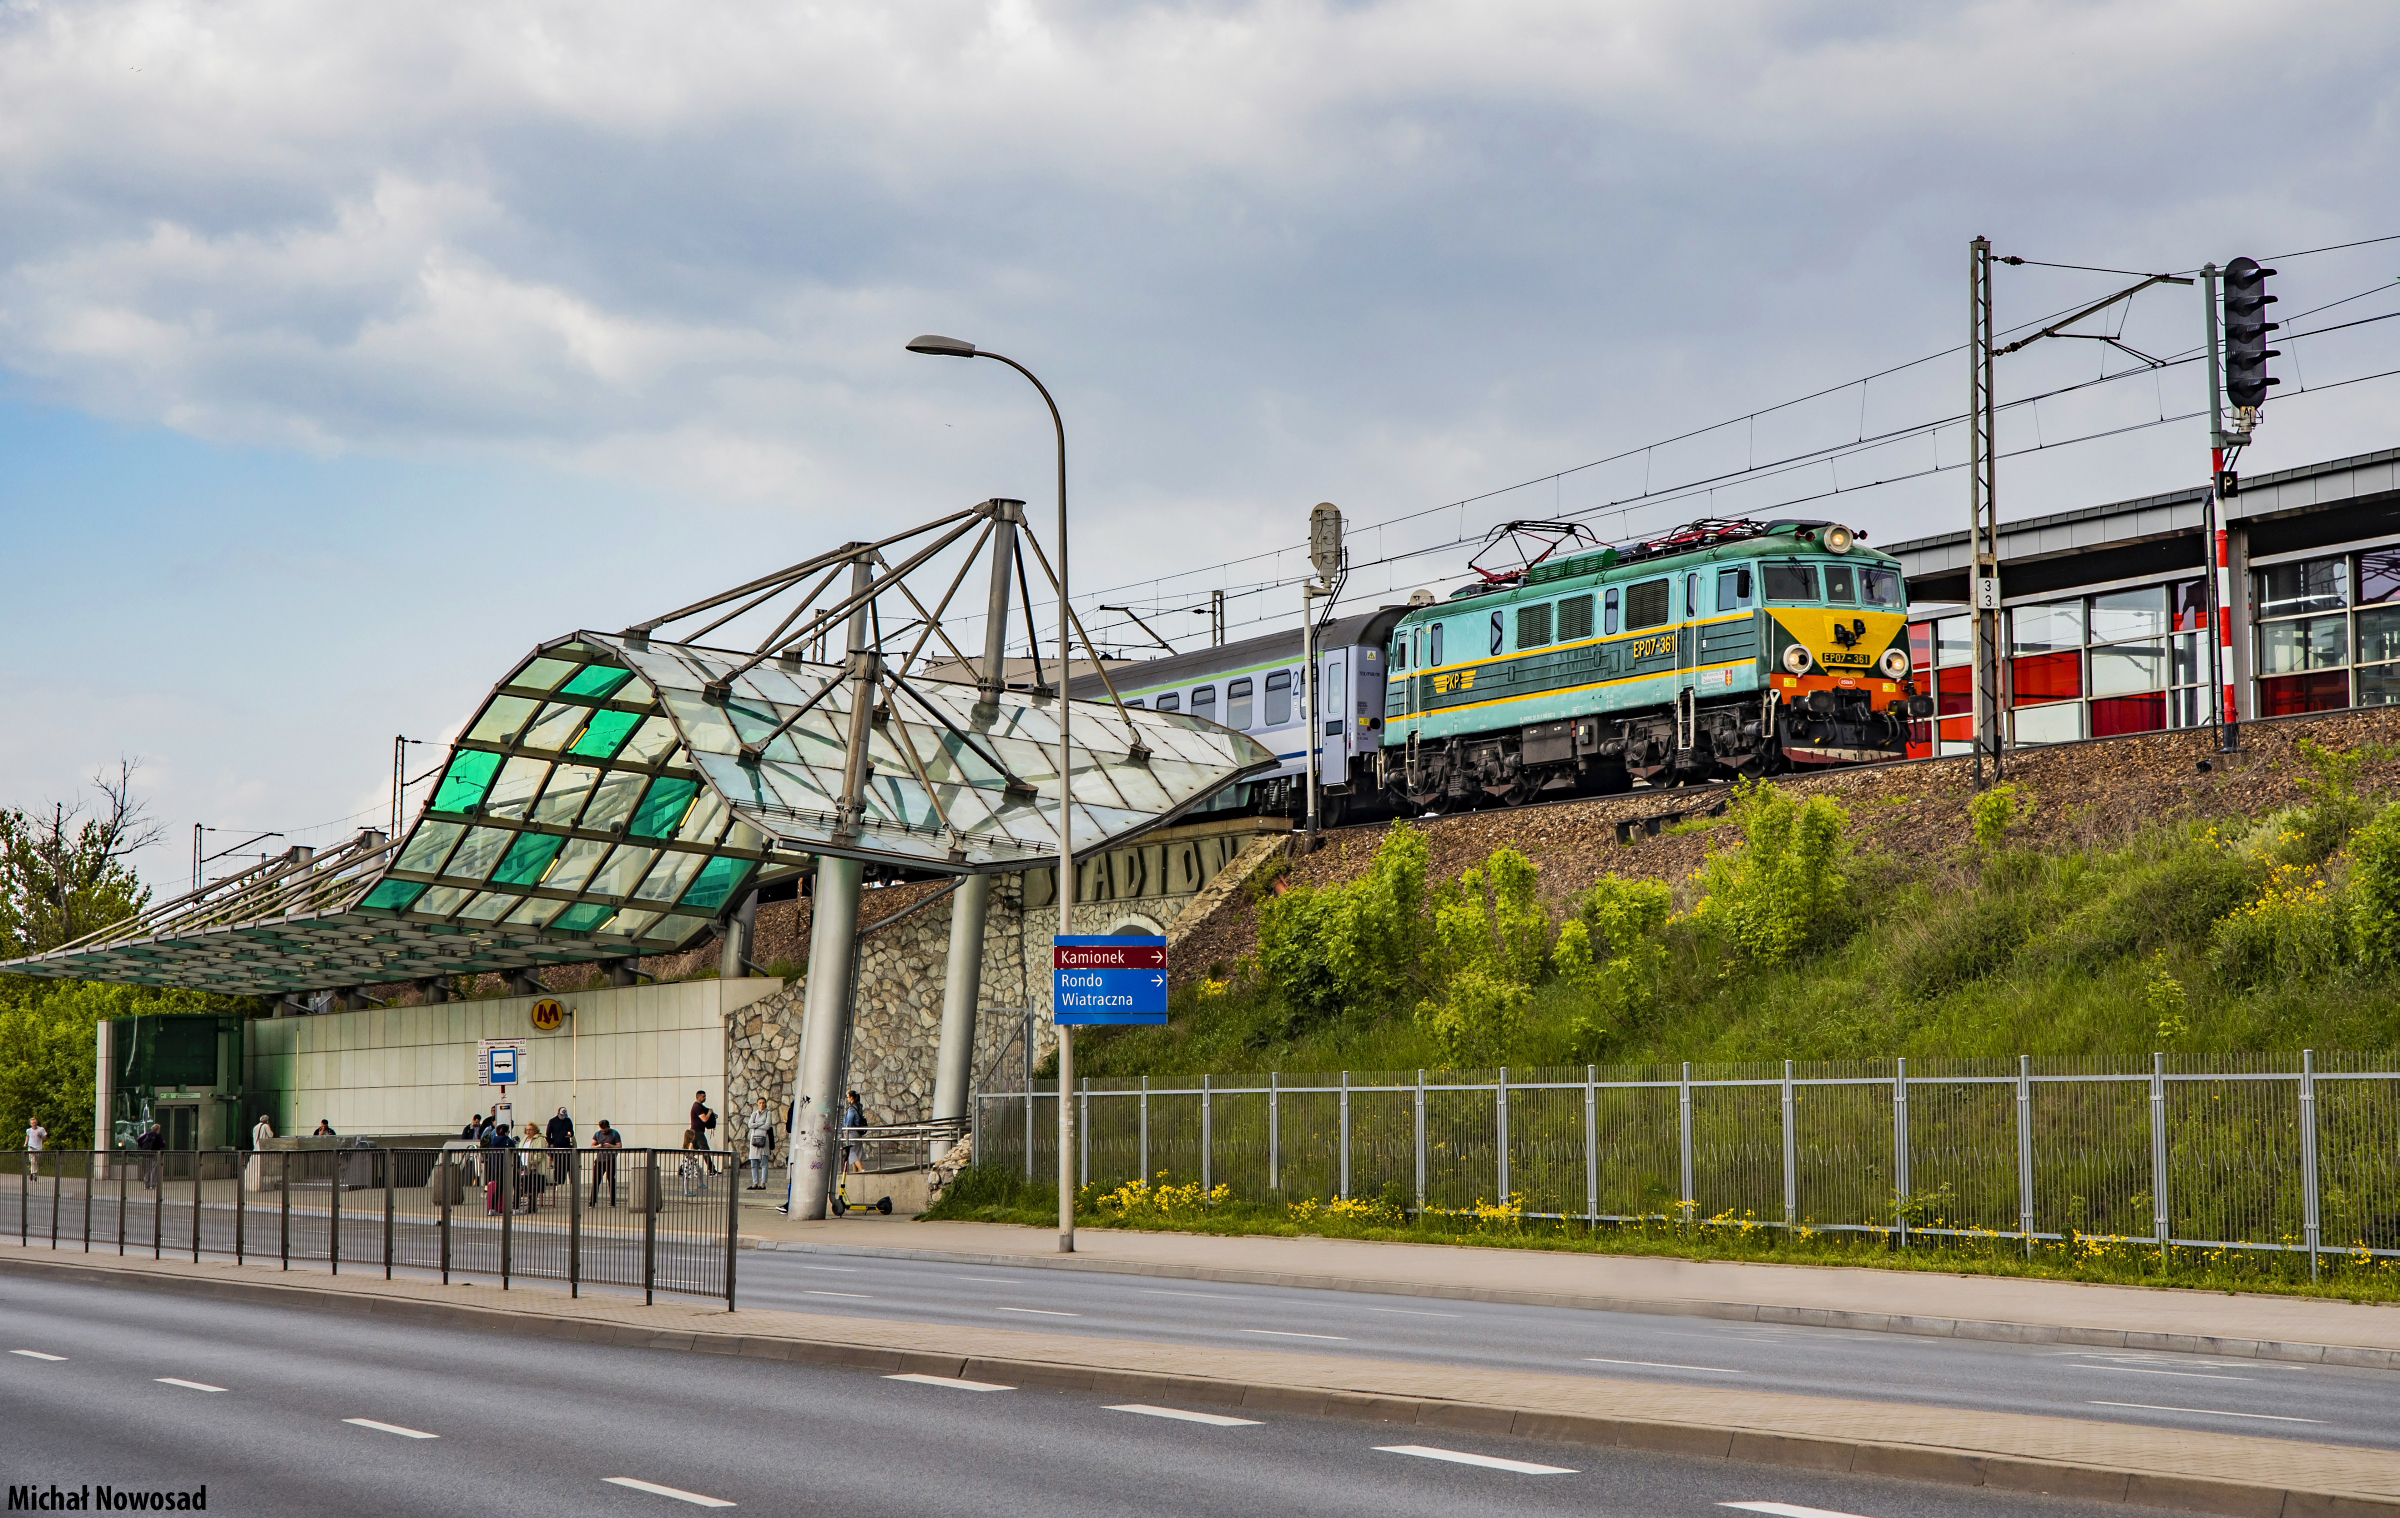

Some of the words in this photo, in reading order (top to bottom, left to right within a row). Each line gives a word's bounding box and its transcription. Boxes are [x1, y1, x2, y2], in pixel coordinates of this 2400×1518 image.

[2224, 476, 2233, 493] P
[1984, 580, 1991, 592] 3
[1985, 595, 1992, 607] 3
[1633, 634, 1675, 659] EP07-361
[1292, 671, 1300, 696] 2
[1446, 673, 1460, 690] PKP
[1030, 836, 1234, 906] SADION
[1061, 950, 1125, 964] Kamionek
[1061, 973, 1103, 987] Rondo
[1062, 993, 1133, 1006] Wiatraczna
[536, 1003, 559, 1024] M
